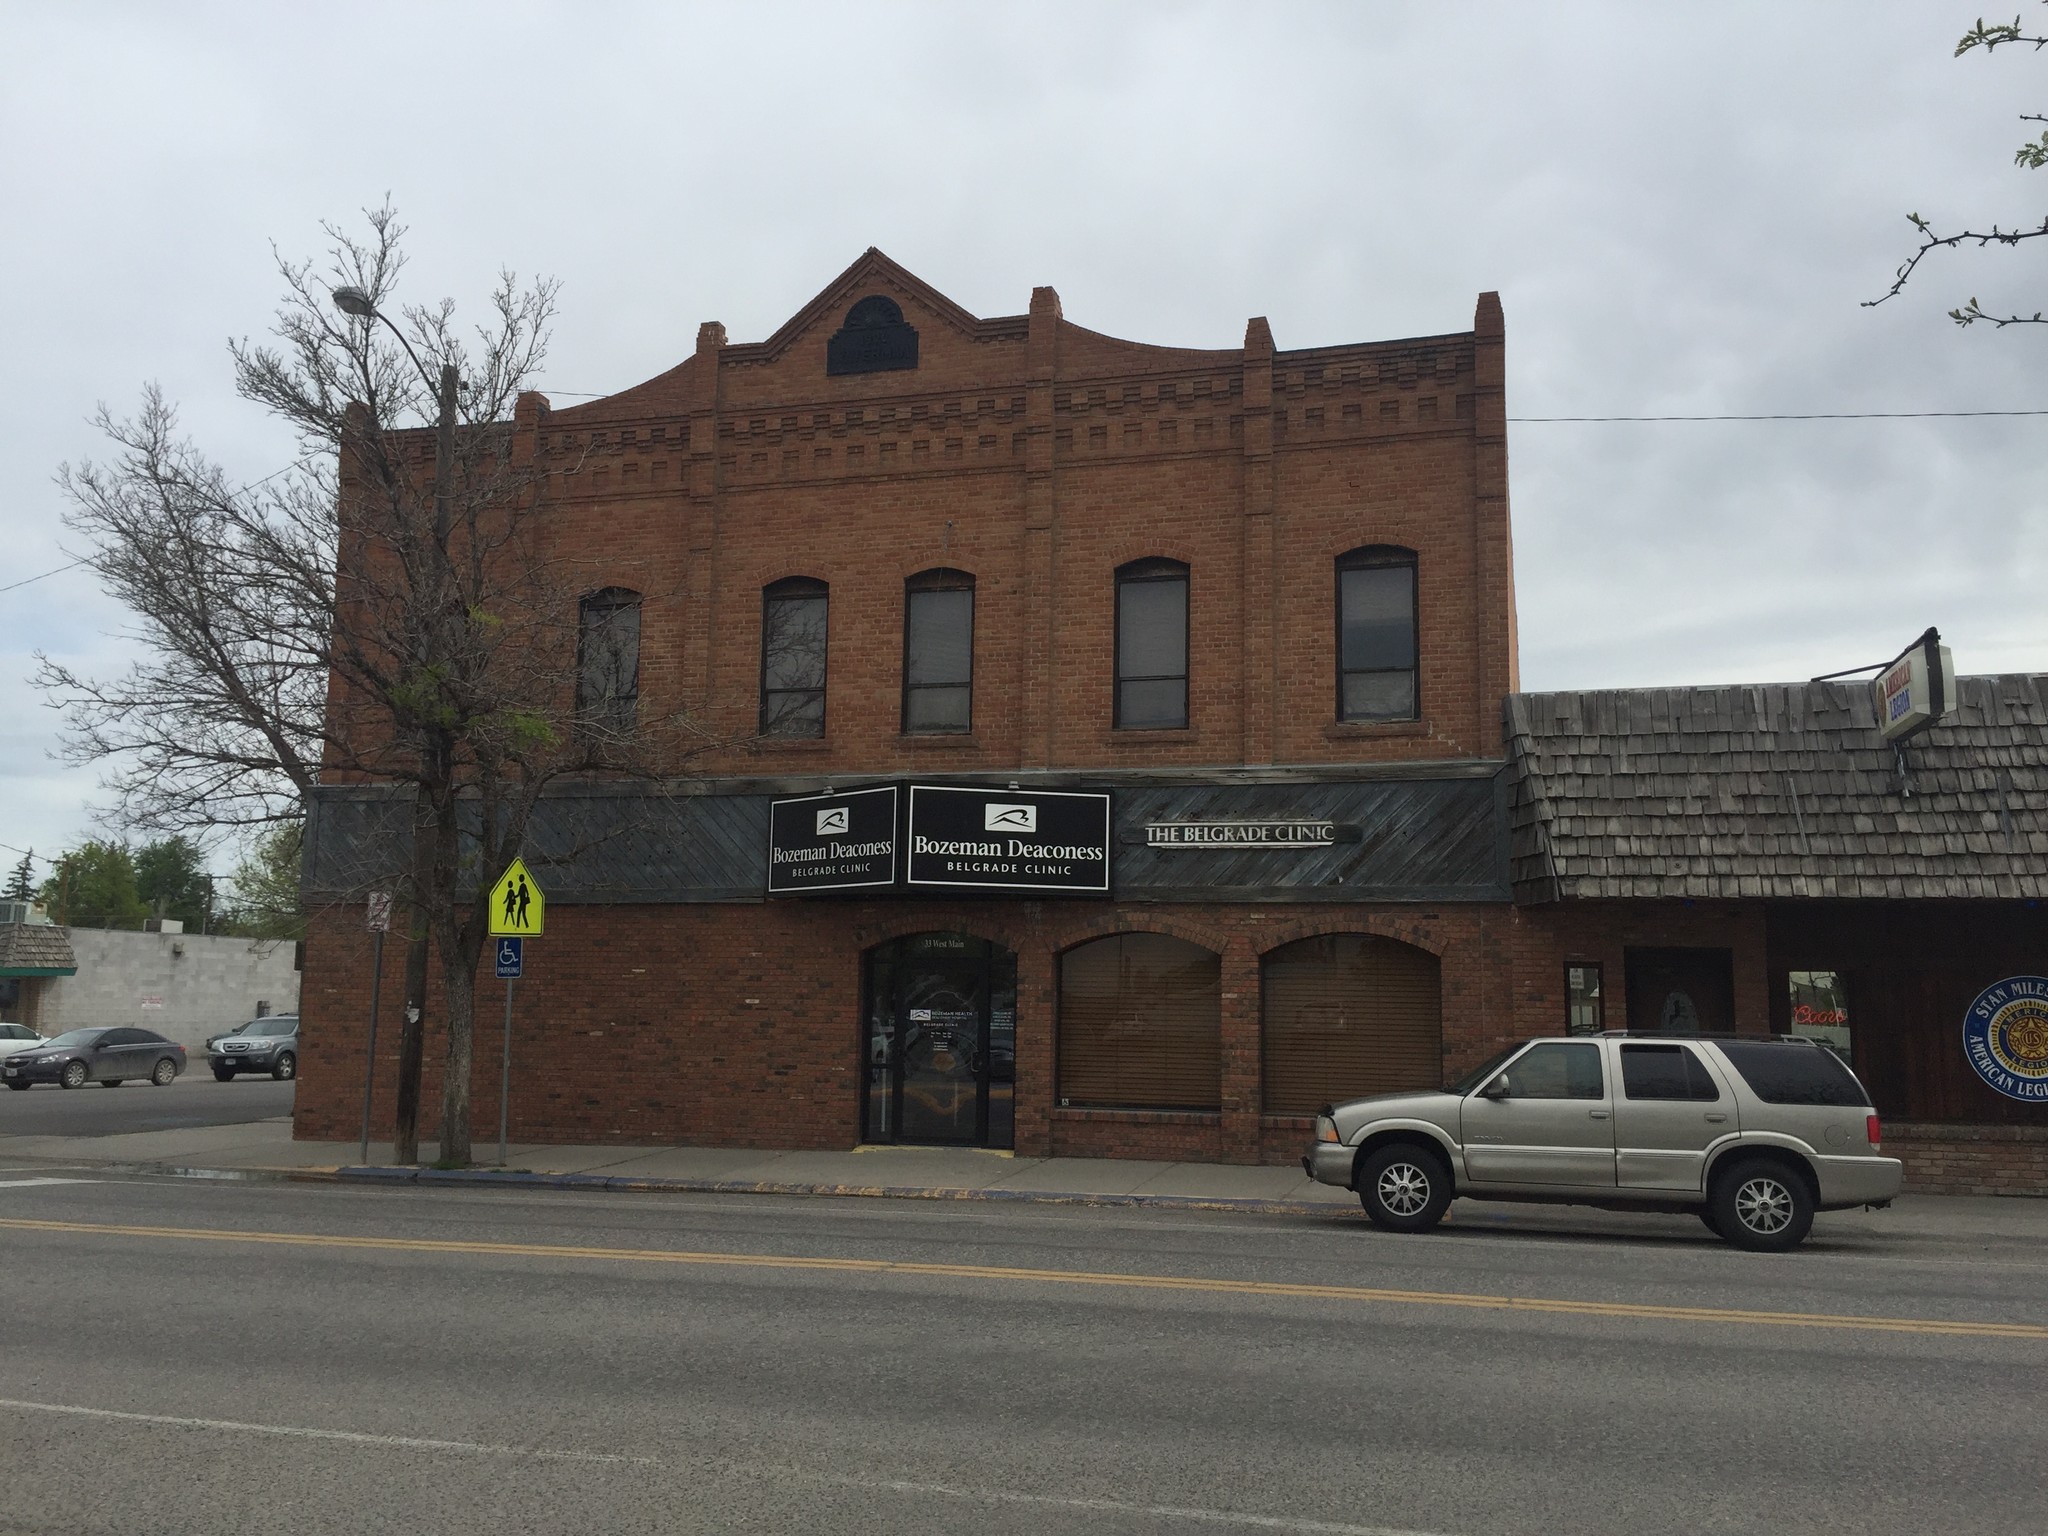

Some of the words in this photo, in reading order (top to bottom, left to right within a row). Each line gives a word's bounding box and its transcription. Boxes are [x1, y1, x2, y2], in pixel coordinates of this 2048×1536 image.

[1145, 827, 1179, 842] THE
[1184, 826, 1271, 842] BELGRADE
[1274, 825, 1335, 841] CLINIC
[773, 843, 827, 864] Bozeman
[829, 839, 892, 860] Deaconess
[914, 835, 1002, 857] Bozeman
[1007, 839, 1103, 861] Deaconess
[792, 866, 836, 878] BELGRADE
[839, 862, 871, 875] CLINIC
[947, 861, 1017, 874] BELGRADE
[1025, 864, 1071, 876] CLINIC
[933, 938, 947, 948] West
[948, 938, 965, 948] Main
[497, 966, 519, 974] PARKING
[1975, 986, 2009, 1019] STAN
[1793, 1005, 1848, 1024] Coors
[1969, 1034, 2015, 1091] AMERICAN
